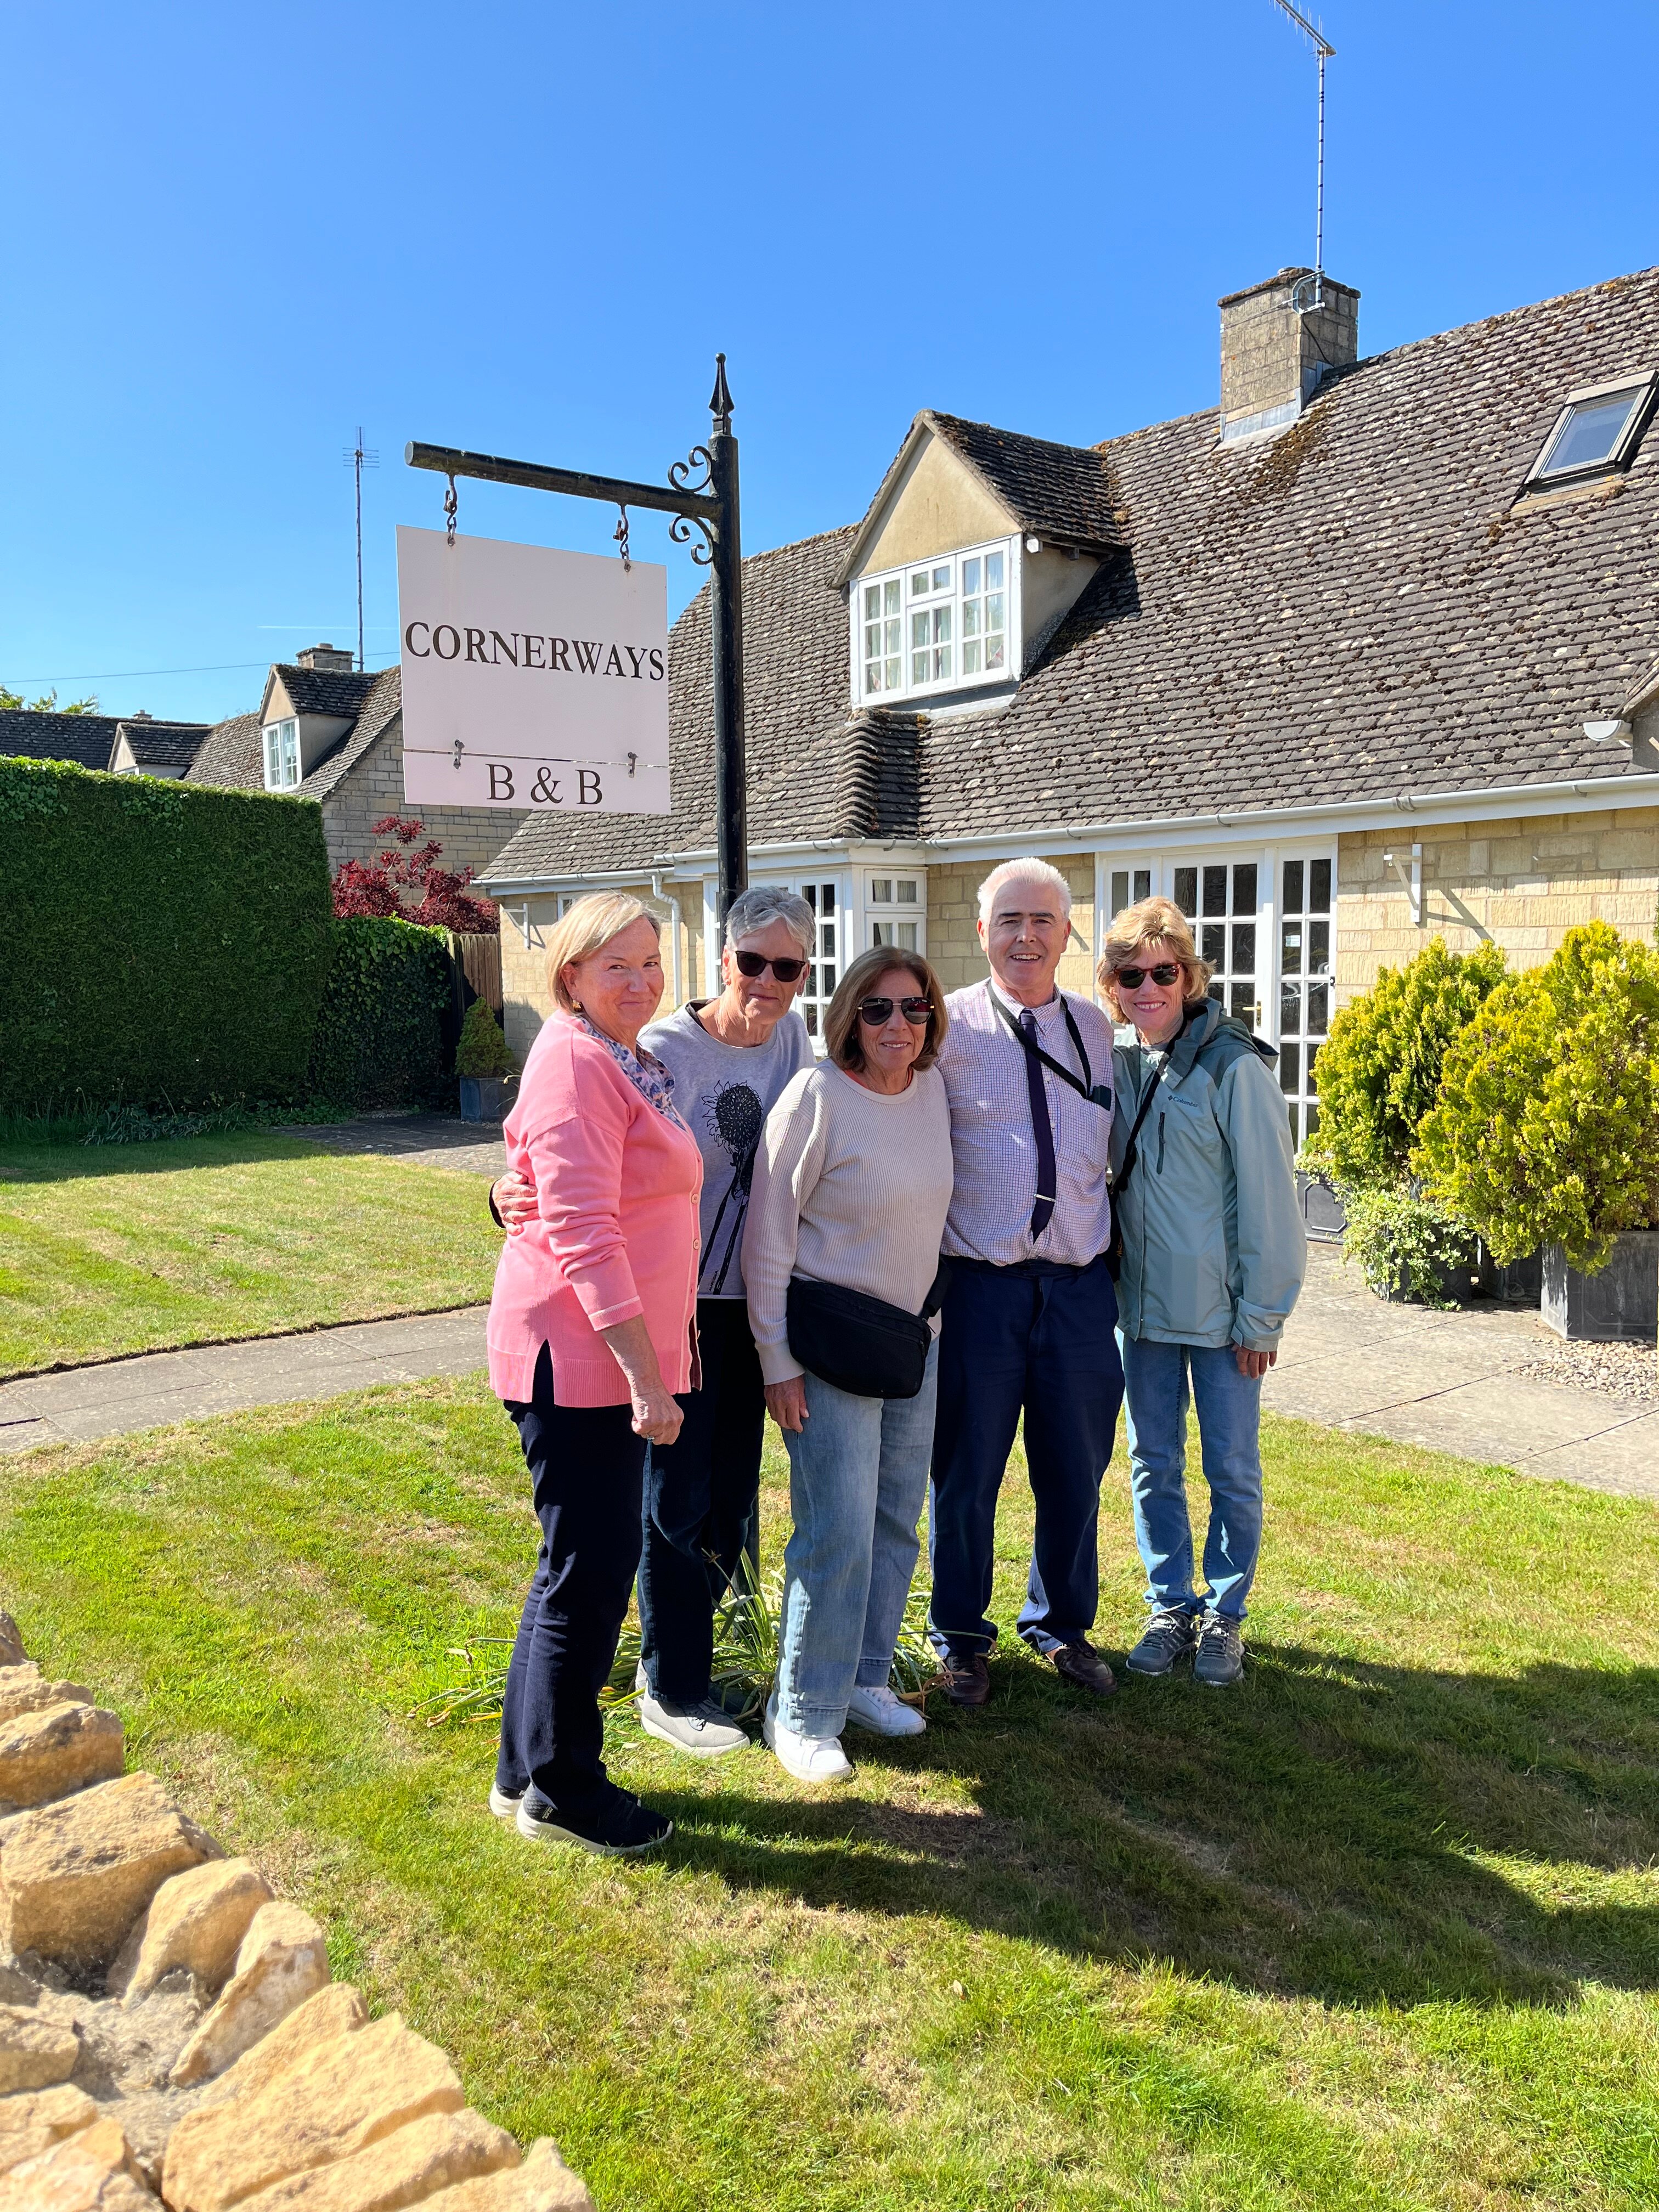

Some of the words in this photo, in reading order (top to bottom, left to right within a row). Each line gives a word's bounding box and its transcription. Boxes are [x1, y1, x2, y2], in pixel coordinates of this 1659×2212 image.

[405, 622, 664, 681] CORNERWAYS
[485, 763, 515, 800] B
[530, 766, 563, 804] &
[576, 769, 602, 805] B
[1173, 1097, 1198, 1108] Columbia
